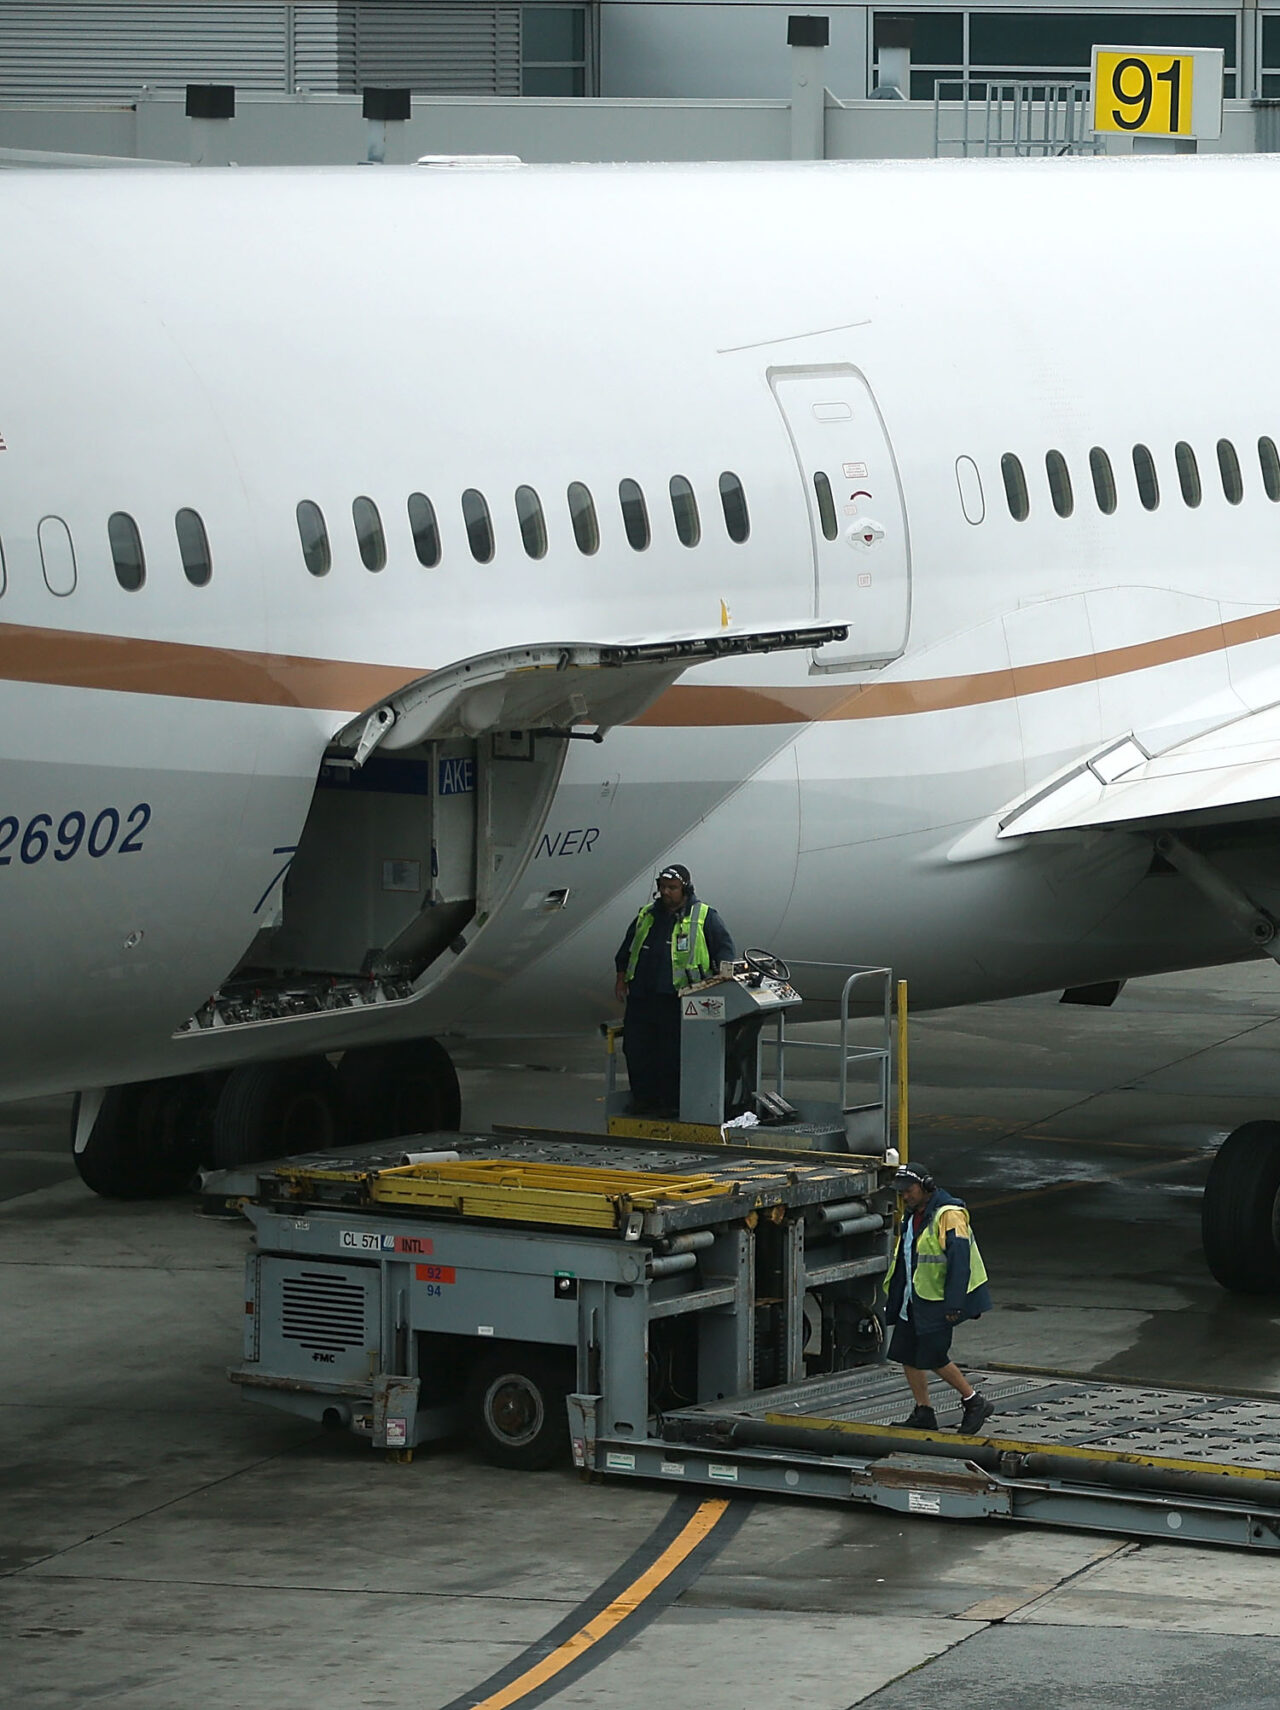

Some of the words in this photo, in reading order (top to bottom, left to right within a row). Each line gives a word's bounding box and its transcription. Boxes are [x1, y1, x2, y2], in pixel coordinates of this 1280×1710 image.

[1111, 57, 1181, 133] 91
[442, 759, 473, 794] AKE
[0, 803, 152, 866] 26902
[534, 827, 600, 860] NER
[343, 1232, 357, 1247] CL
[361, 1234, 379, 1249] 571
[402, 1239, 424, 1254] INTL
[427, 1267, 442, 1280] 92
[427, 1284, 442, 1297] 94
[312, 1352, 335, 1363] FMC
